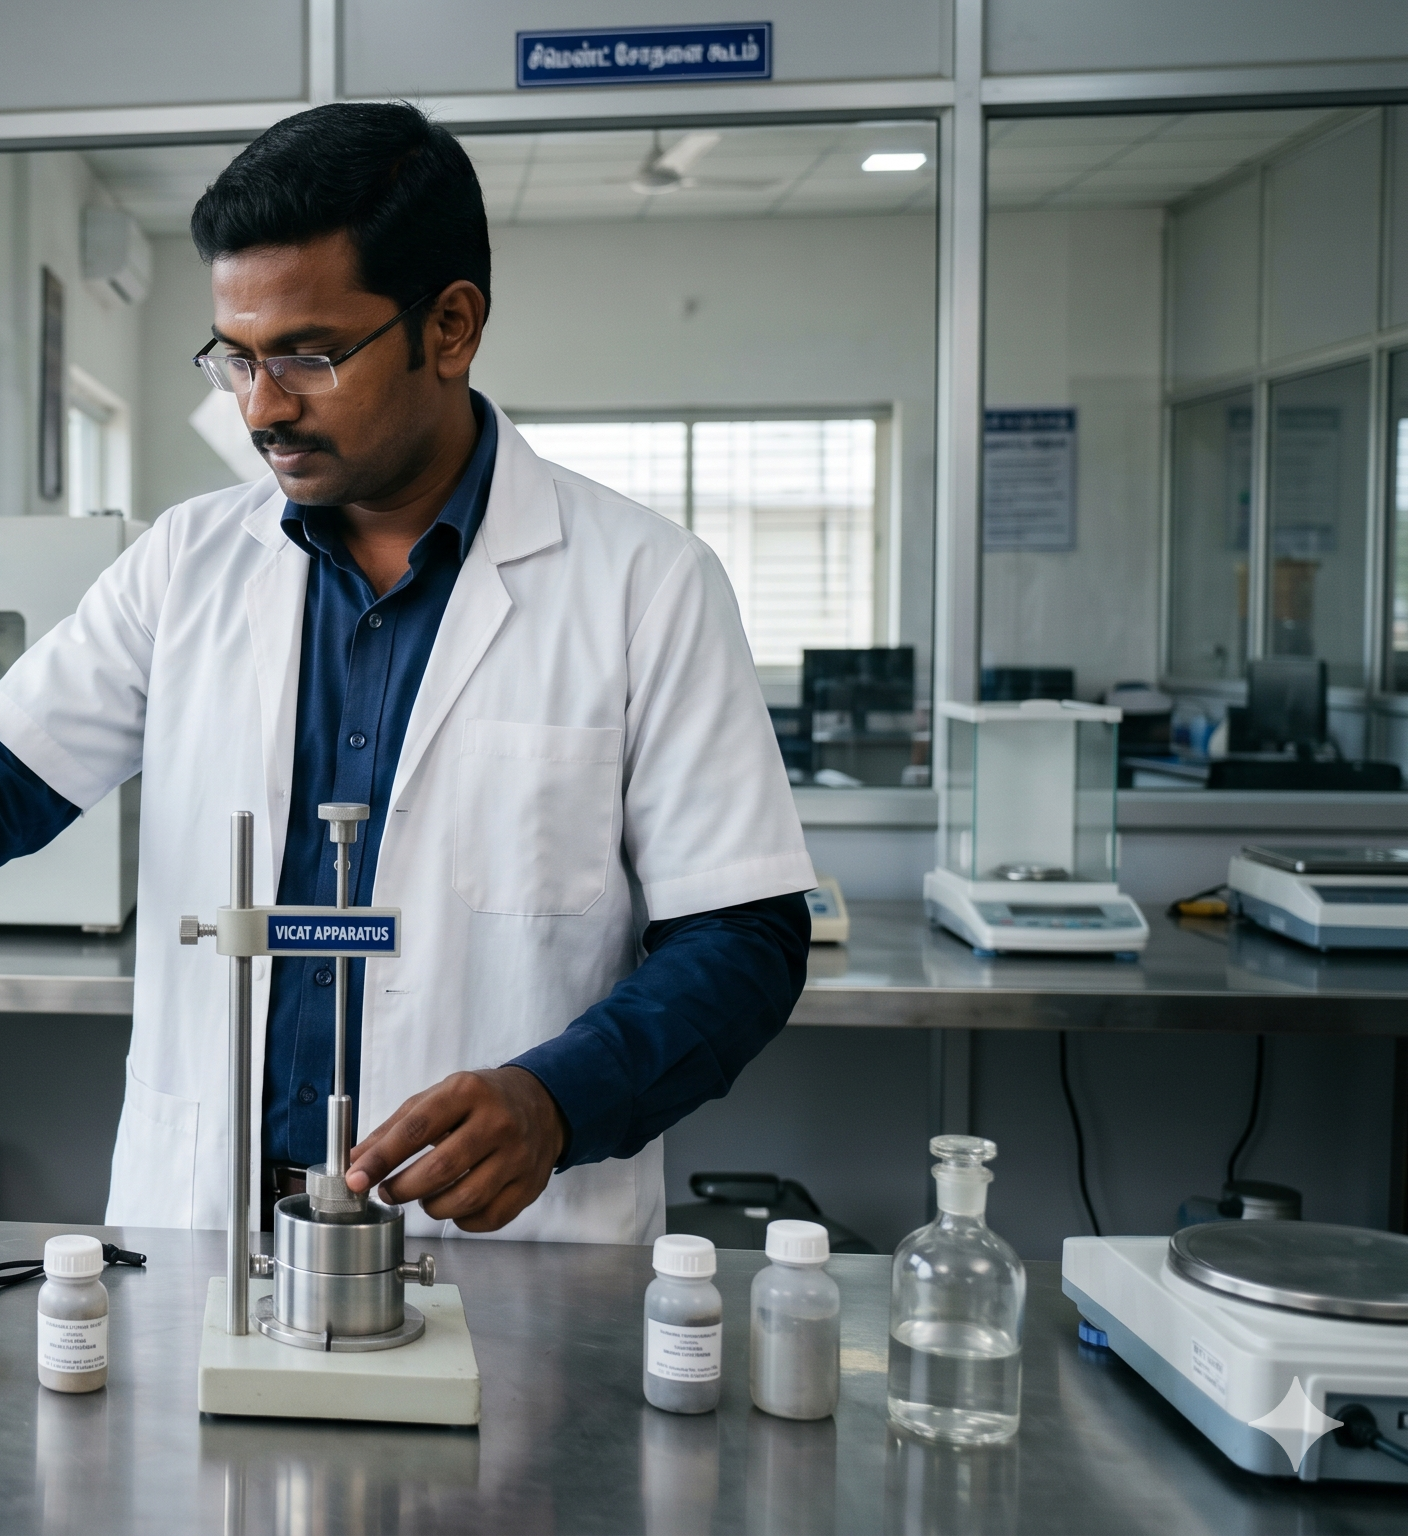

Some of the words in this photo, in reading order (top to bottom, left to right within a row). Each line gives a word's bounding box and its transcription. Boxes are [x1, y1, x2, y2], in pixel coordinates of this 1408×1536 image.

[614, 41, 703, 71] சோதனை
[707, 34, 760, 62] கூடம்
[275, 925, 312, 941] VICAT
[314, 925, 389, 941] APPARATUS
